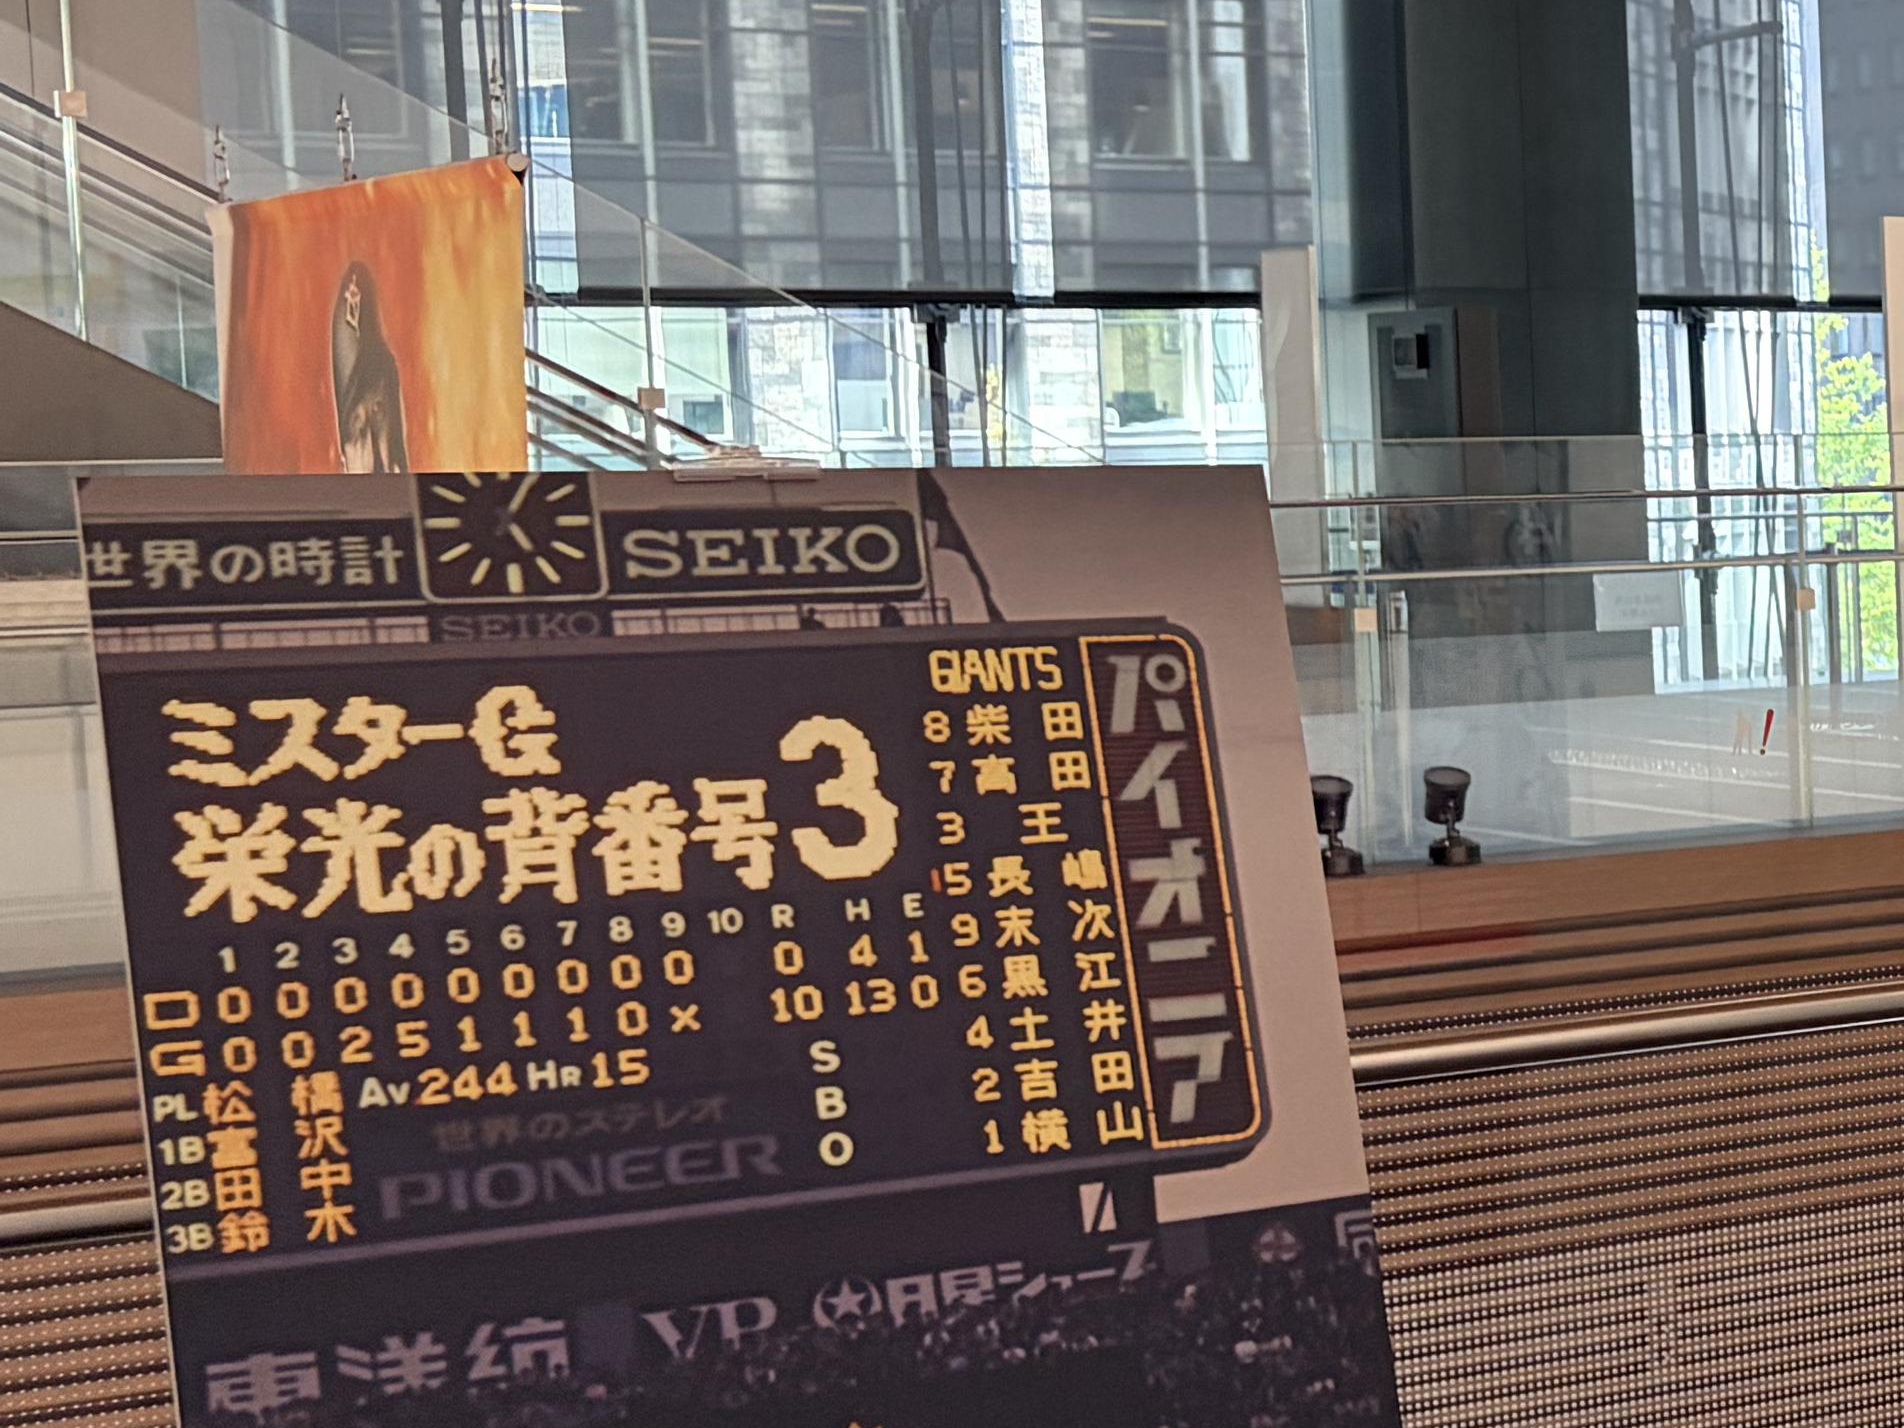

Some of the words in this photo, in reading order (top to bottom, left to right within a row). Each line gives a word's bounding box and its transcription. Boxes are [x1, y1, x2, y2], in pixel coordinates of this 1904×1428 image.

[86, 535, 404, 589] 世界の時計
[623, 523, 901, 579] SEIKO
[441, 610, 599, 642] SEIKO
[928, 646, 1063, 693] GIANTS
[923, 710, 951, 742] 8
[929, 761, 956, 793] 7
[172, 778, 778, 923] 栄光の背番号
[780, 715, 899, 880] 3
[936, 812, 965, 844] 3
[1018, 802, 1069, 845] 王
[1106, 653, 1235, 1123] パイオニア
[218, 946, 237, 972] 1
[275, 942, 299, 968] 2
[332, 937, 358, 964] 3
[389, 933, 414, 958] 4
[446, 929, 471, 955] 5
[501, 924, 526, 950] 6
[557, 920, 577, 946] 7
[609, 916, 634, 943] 8
[661, 911, 686, 937] 9
[707, 907, 743, 934] 10
[771, 904, 795, 929] R
[846, 898, 871, 922] H
[903, 893, 924, 918] E
[951, 913, 979, 947] 9
[958, 964, 987, 999] 6
[223, 1036, 257, 1072] 0
[282, 1031, 315, 1068] 0
[340, 1026, 373, 1063] 2
[396, 1021, 430, 1058] 5
[457, 1016, 481, 1052] 1
[513, 1011, 537, 1047] 1
[567, 1006, 590, 1043] 1
[617, 1001, 648, 1036] 0
[770, 986, 823, 1022] 10
[845, 979, 897, 1015] 13
[910, 975, 938, 1008] 0
[966, 1016, 994, 1049] 4
[809, 1040, 841, 1073] S
[972, 1067, 1001, 1102] 2
[153, 1094, 198, 1122] PL
[815, 1086, 847, 1120] B
[158, 1135, 205, 1166] 1B
[819, 1131, 855, 1166] O
[983, 1119, 1004, 1154] 1
[379, 1133, 784, 1220] PIONEER
[161, 1179, 211, 1210] 2B
[167, 1222, 215, 1253] 3B
